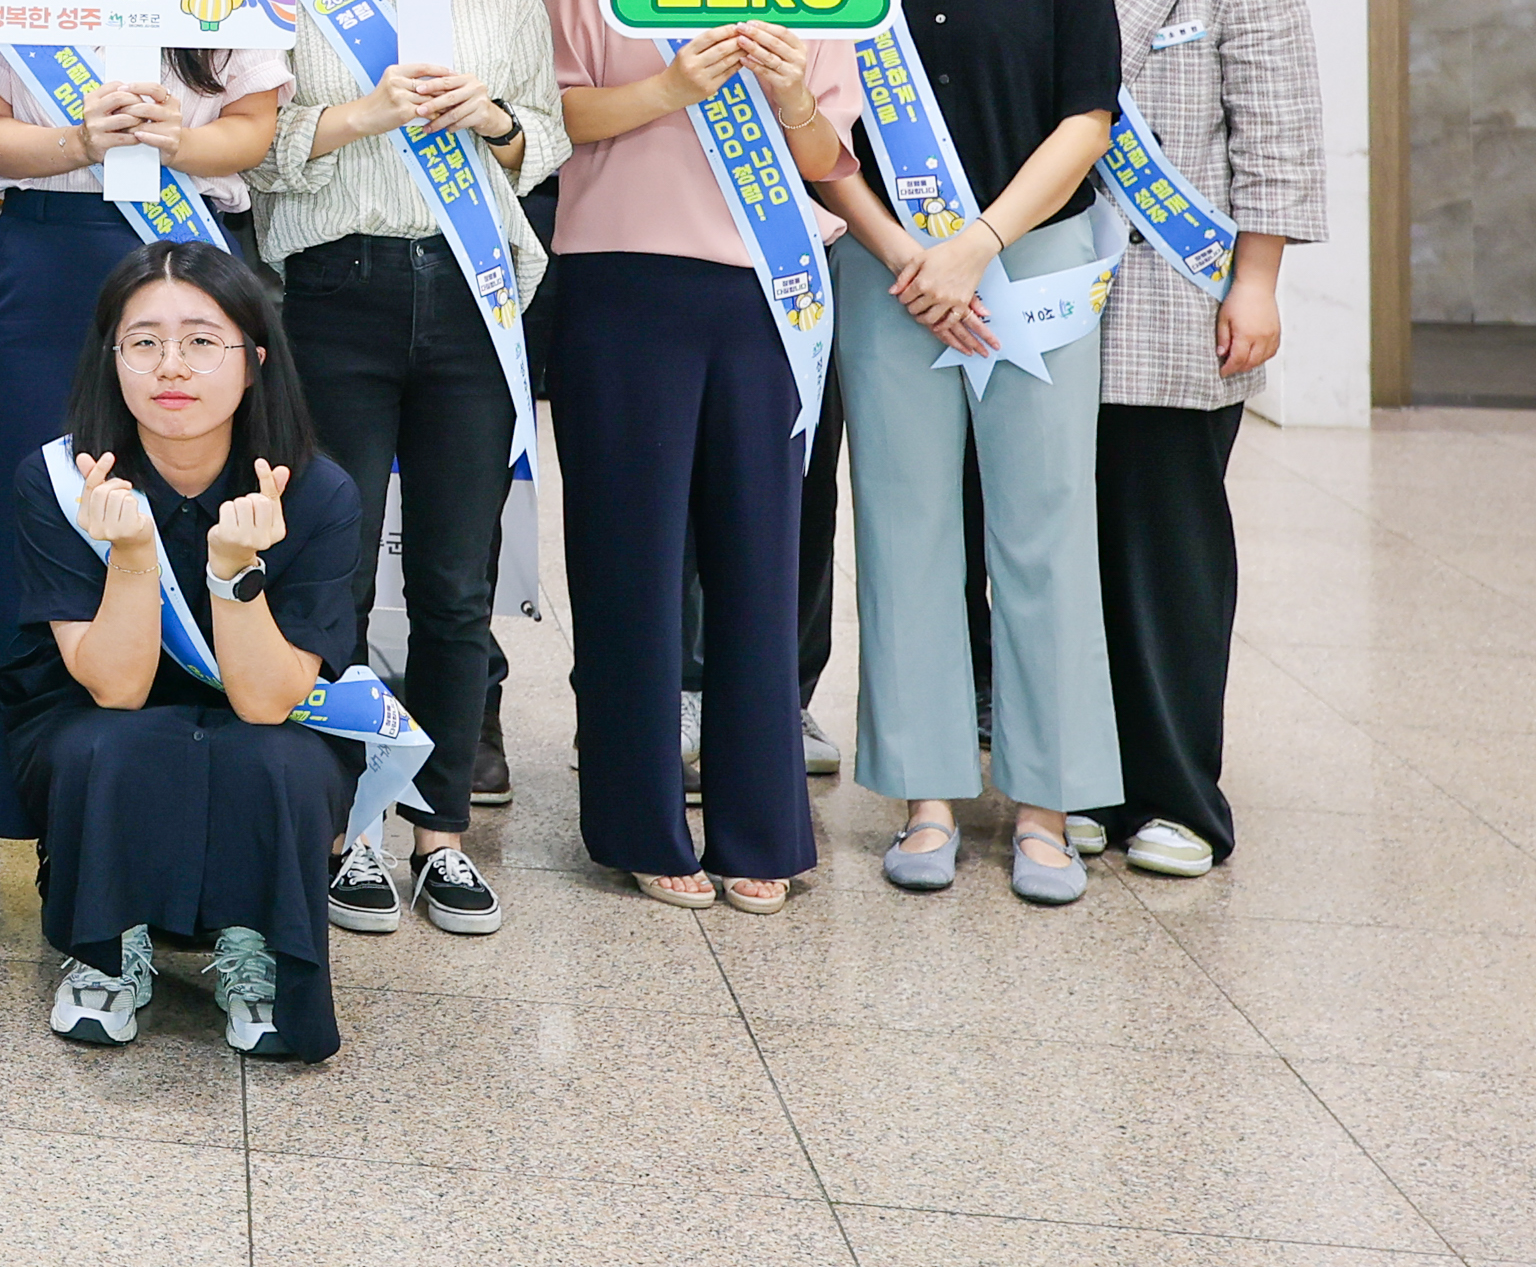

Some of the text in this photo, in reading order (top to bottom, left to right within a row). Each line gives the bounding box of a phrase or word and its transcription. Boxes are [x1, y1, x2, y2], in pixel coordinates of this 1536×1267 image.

[56, 6, 102, 31] 성주
[127, 13, 161, 24] 성주군
[335, 1, 376, 30] 청렴
[855, 49, 900, 127] 기본으로
[417, 145, 461, 206] 것부터
[435, 132, 482, 206] 나부터!
[731, 164, 767, 222] 청렴!
[159, 182, 201, 238] 함께!
[1134, 187, 1170, 225] 성주
[1149, 178, 1201, 229] 함께!
